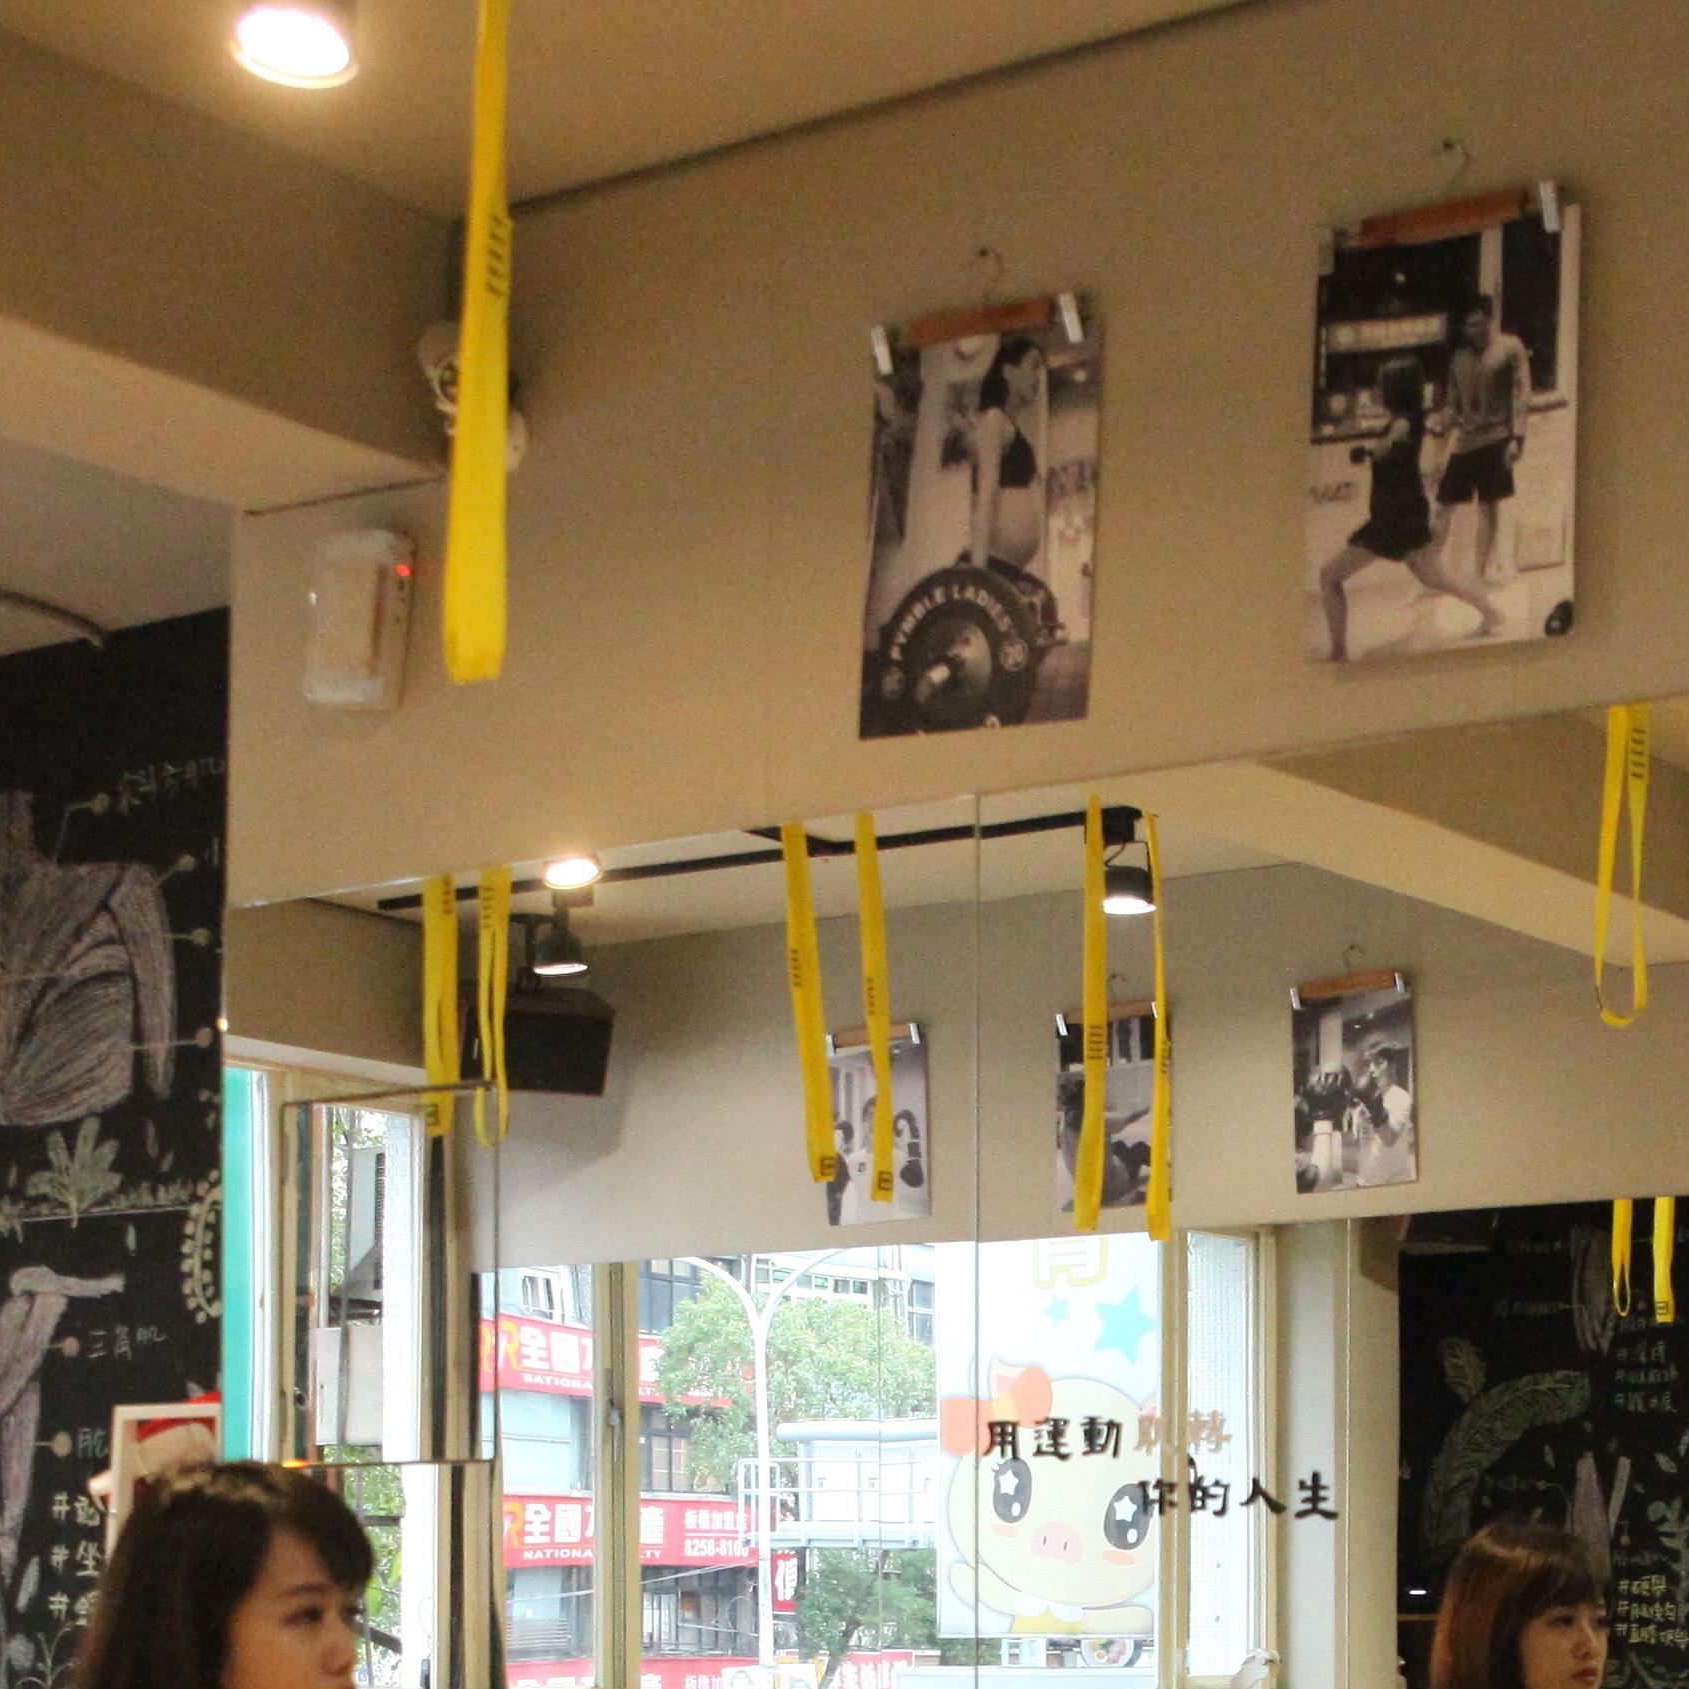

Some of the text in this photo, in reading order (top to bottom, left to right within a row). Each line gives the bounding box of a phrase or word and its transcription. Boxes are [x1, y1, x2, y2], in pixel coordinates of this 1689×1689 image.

[1138, 1470, 1340, 1520] 你的人生
[523, 1548, 595, 1561] NATIONA
